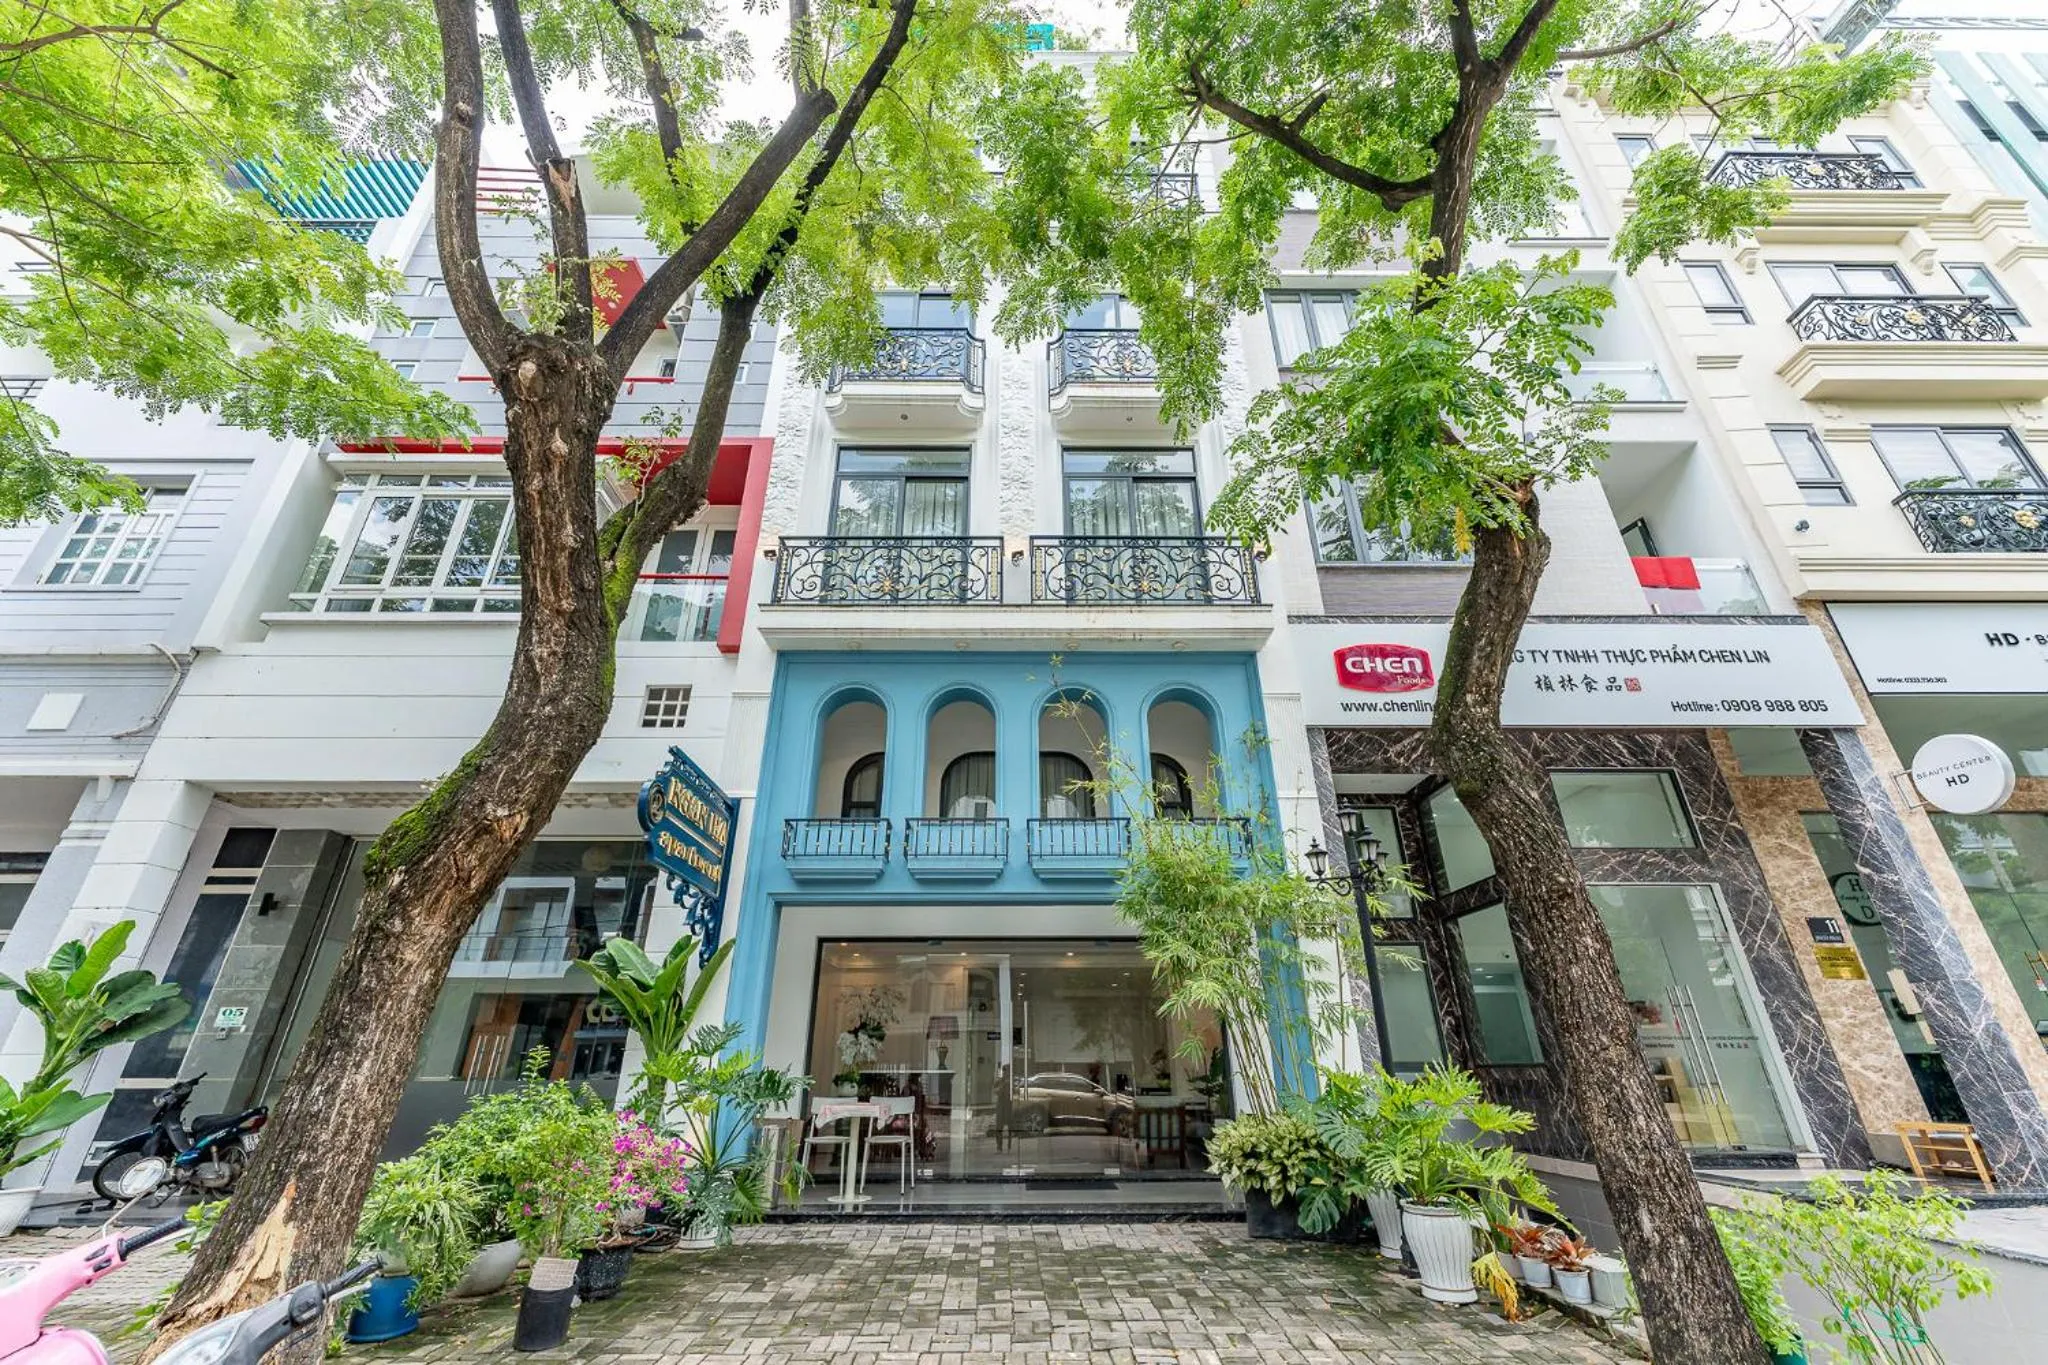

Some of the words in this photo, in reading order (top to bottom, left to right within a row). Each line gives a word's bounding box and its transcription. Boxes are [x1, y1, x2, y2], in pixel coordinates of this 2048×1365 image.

[1984, 632, 2020, 647] HD
[2034, 634, 2048, 646] B
[1527, 649, 1549, 663] TY
[1552, 649, 1599, 664] TNHH
[1601, 649, 1648, 666] THỰC
[1698, 649, 1743, 664] CHEN
[1743, 649, 1771, 664] LIN
[1720, 699, 1763, 713] 0908
[1764, 699, 1797, 713] 988
[1798, 699, 1829, 713] 805
[1916, 766, 1950, 780] BEAUTY
[1953, 755, 1991, 770] CENTER
[1945, 773, 1970, 787] HD
[1848, 878, 1863, 892] H
[1861, 905, 1874, 919] D
[1825, 920, 1840, 933] 11
[222, 1008, 244, 1017] 05
